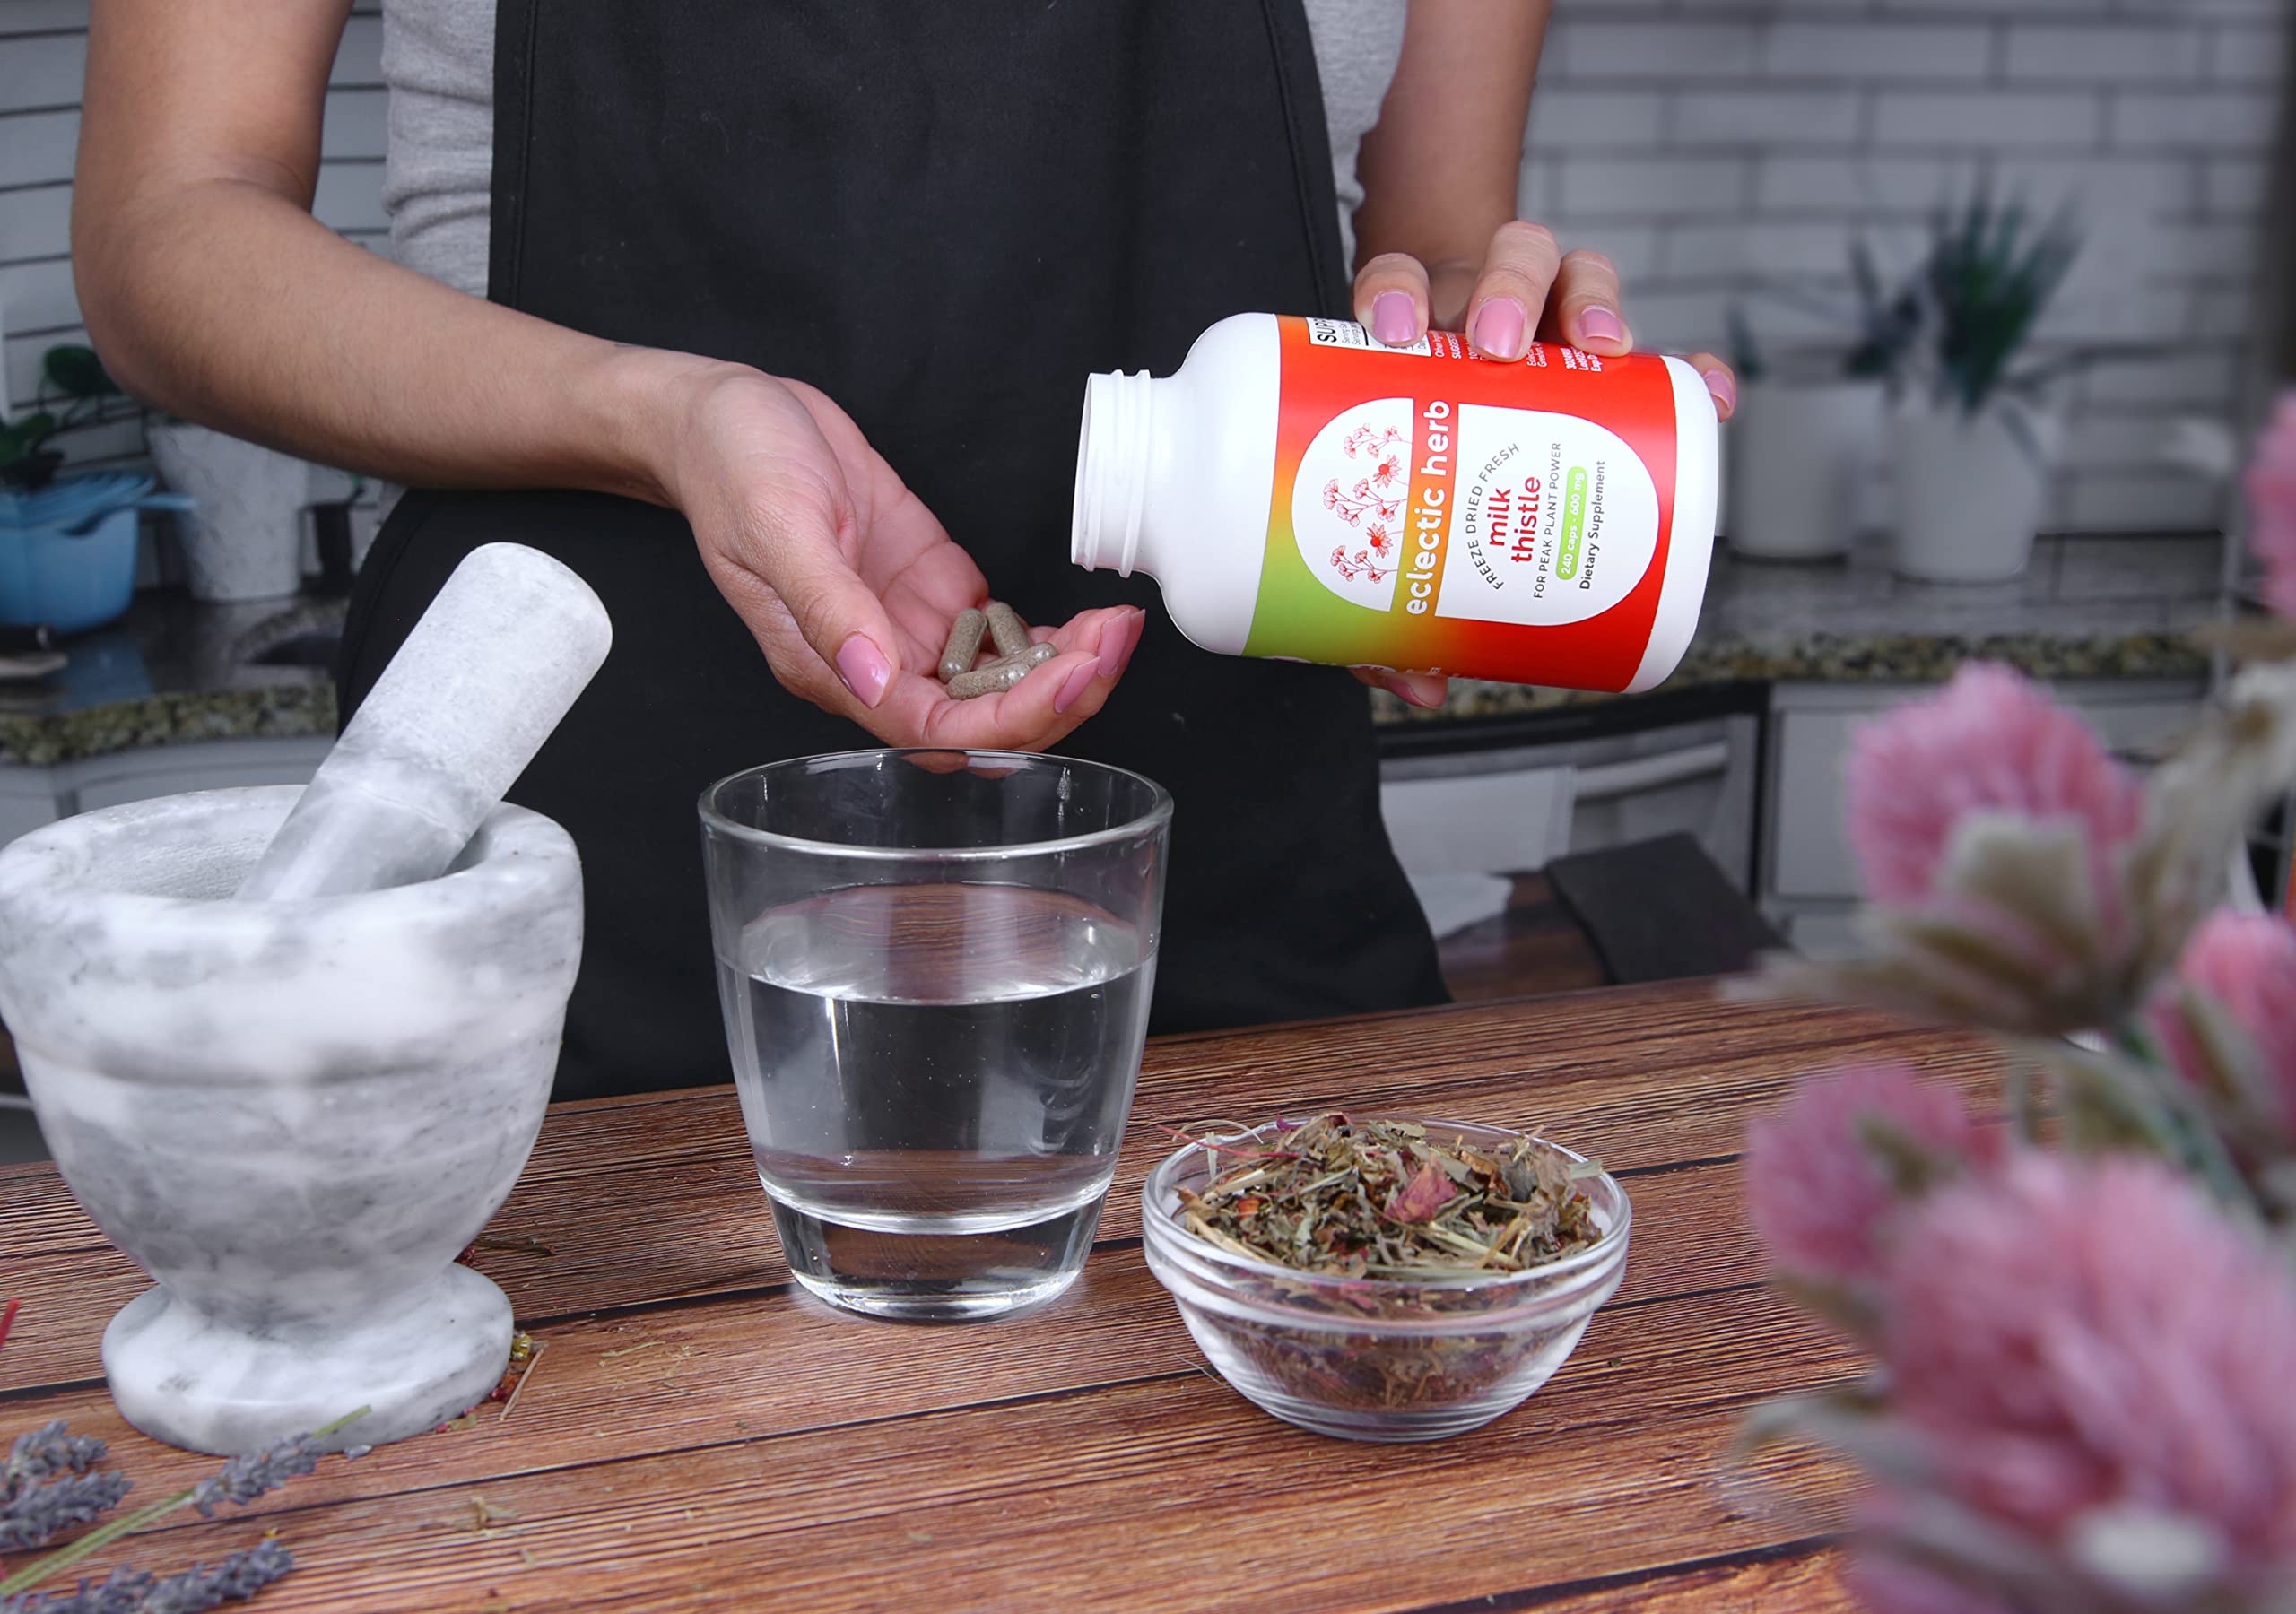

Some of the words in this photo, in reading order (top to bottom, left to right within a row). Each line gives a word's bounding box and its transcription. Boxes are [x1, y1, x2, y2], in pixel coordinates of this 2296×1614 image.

[1421, 401, 1451, 476] herb
[1478, 443, 1519, 482] FRESH
[1549, 442, 1561, 490] POWER
[1574, 473, 1586, 491] mg
[1465, 485, 1483, 534] DRIED
[1487, 488, 1511, 546] milk
[1511, 476, 1541, 563] thistle
[1544, 493, 1558, 536] PLANT
[1570, 493, 1581, 516] 600
[1587, 460, 1605, 539] Supplement
[1406, 487, 1446, 615] eclectic
[1538, 539, 1552, 572] PEAK
[1567, 525, 1578, 551] caps
[1467, 539, 1504, 591] FREEZE
[1534, 576, 1547, 599] FOR
[1561, 553, 1574, 575] 240
[1579, 543, 1600, 590] Dietary
